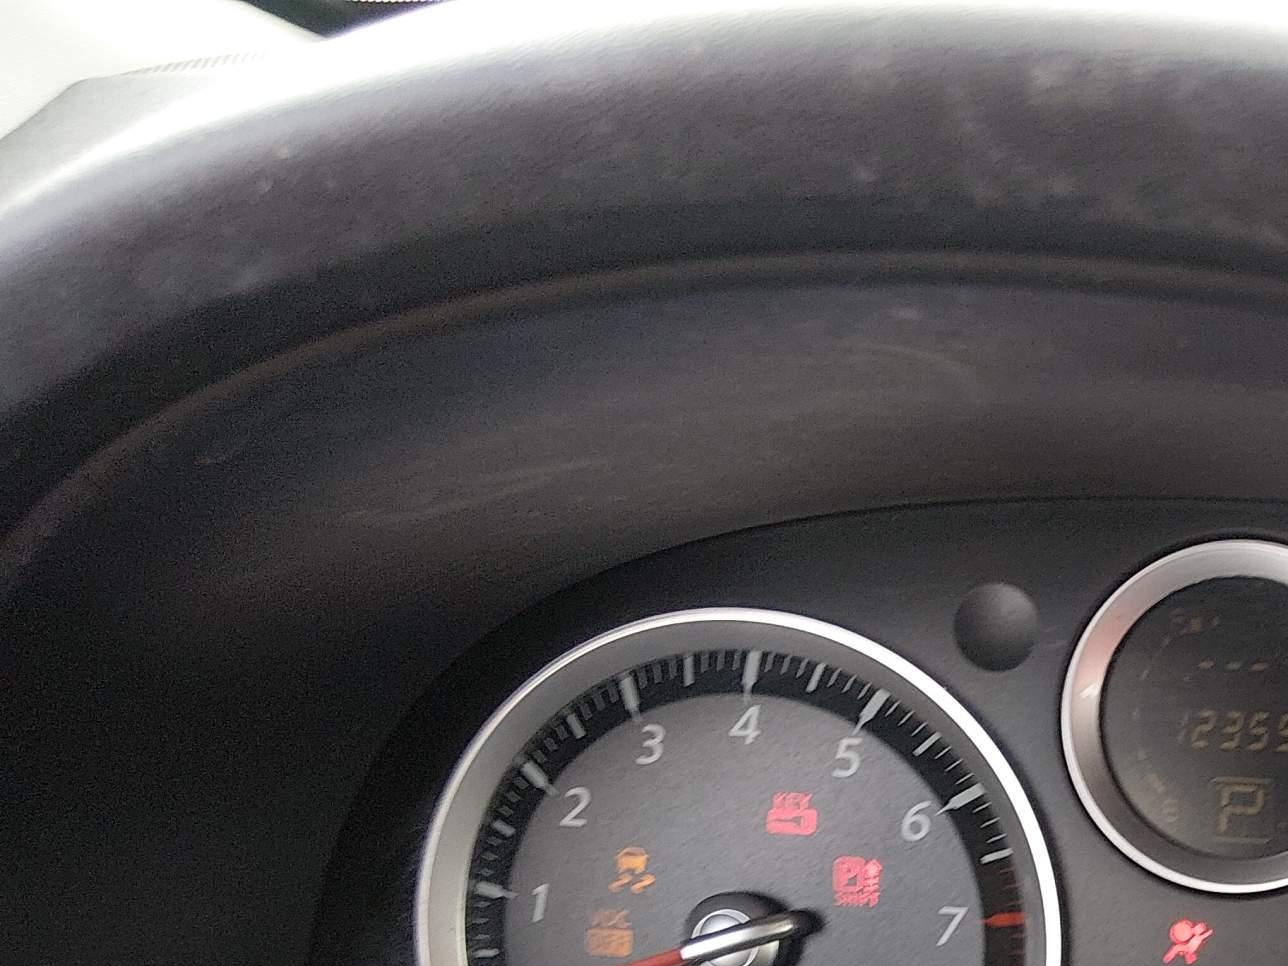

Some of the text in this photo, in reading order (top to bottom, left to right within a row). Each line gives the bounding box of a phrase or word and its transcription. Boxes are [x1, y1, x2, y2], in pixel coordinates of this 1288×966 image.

[636, 724, 666, 765] 3
[730, 705, 760, 745] 4
[832, 738, 862, 777] 5
[559, 787, 591, 827] 2
[902, 801, 931, 841] 6
[531, 884, 549, 922] 1
[936, 906, 968, 946] 7
